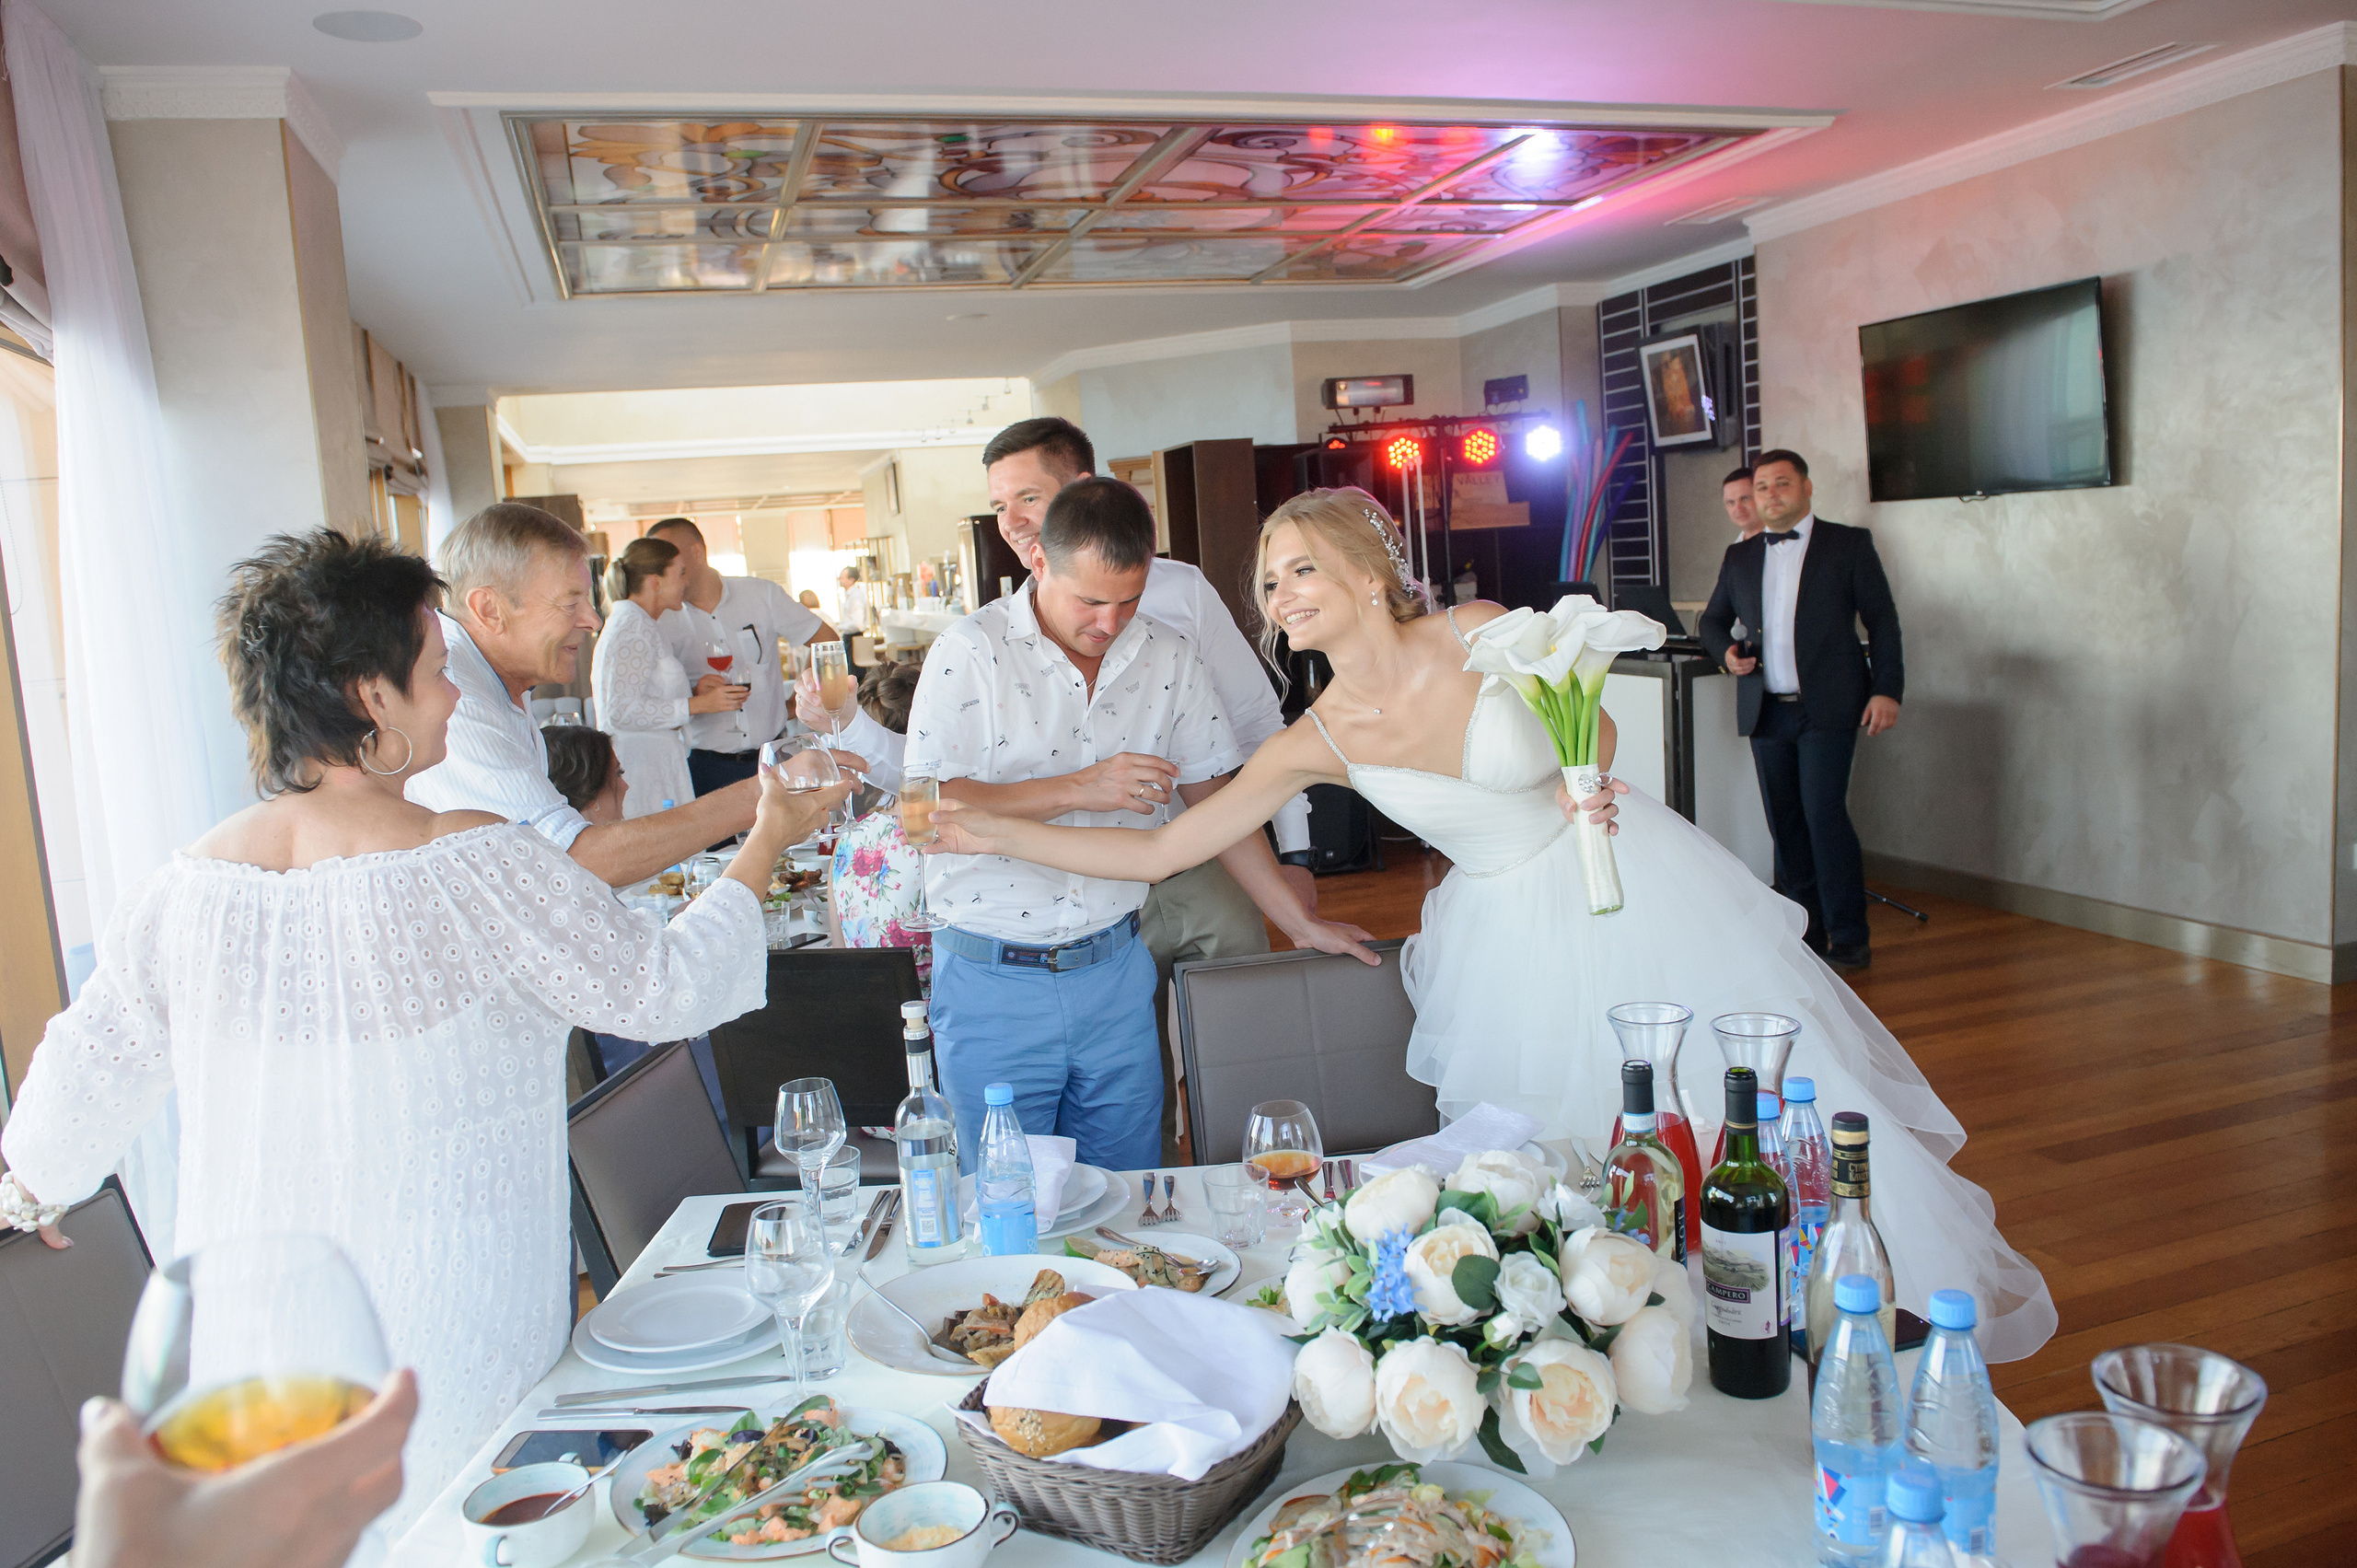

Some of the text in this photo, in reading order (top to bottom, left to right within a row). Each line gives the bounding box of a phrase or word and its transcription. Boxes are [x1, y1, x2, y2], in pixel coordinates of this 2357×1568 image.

[1457, 475, 1501, 486] VALLEY
[1678, 1212, 1687, 1264] INOT
[1707, 1283, 1747, 1299] CAMPERO
